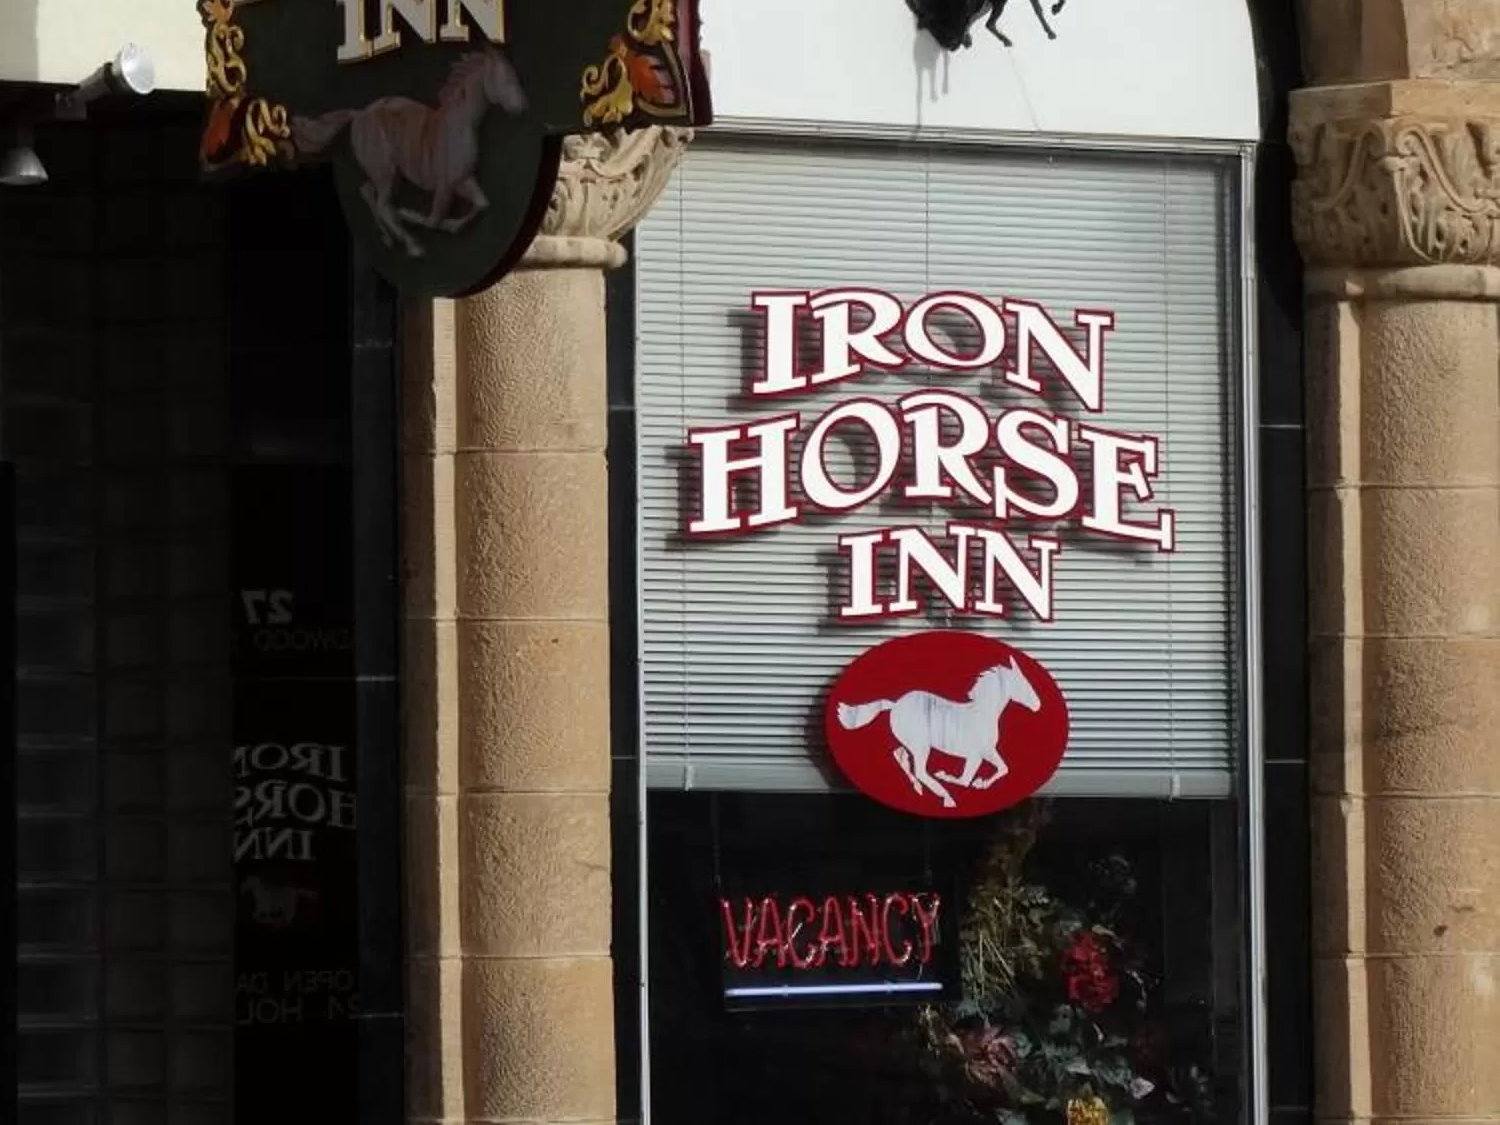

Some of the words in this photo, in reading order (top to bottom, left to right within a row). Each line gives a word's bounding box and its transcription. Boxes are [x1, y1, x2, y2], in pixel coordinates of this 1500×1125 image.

[750, 286, 1113, 413] IRON
[688, 387, 1175, 552] HORSE
[837, 521, 1061, 623] INN
[719, 891, 941, 968] VACANCY
